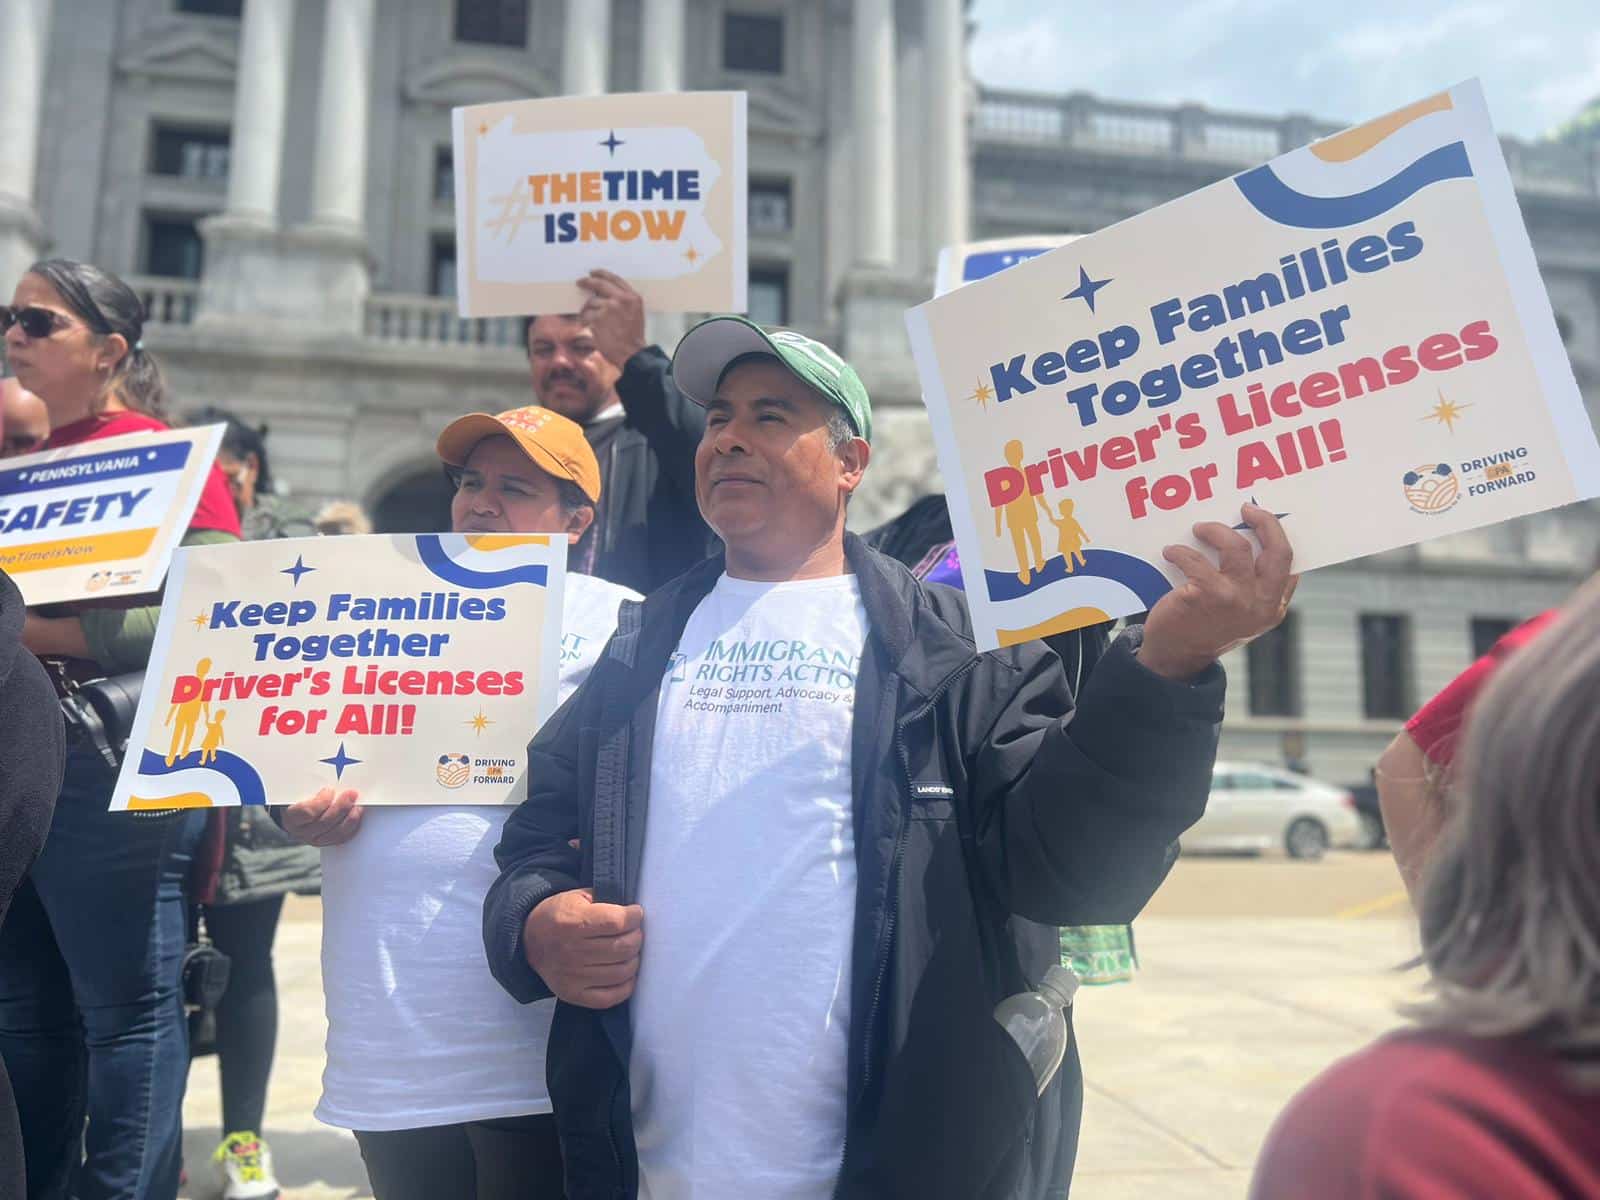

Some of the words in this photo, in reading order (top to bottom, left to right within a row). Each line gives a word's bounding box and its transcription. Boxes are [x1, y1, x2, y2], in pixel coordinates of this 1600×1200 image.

[990, 326, 1141, 402] Keep
[1150, 221, 1424, 345] Families
[1066, 305, 1351, 427] Together
[984, 413, 1207, 508] Driver's
[1217, 320, 1499, 436] Licenses
[29, 455, 139, 484] PENNSYLVANIA
[1125, 463, 1218, 519] for
[1236, 418, 1348, 489] All!
[1461, 447, 1528, 473] DRIVING
[1468, 470, 1536, 497] FORWARD
[209, 601, 316, 629] Keep
[327, 593, 506, 621] Families
[253, 629, 449, 661] Together
[171, 668, 330, 704] Driver's
[342, 665, 524, 696] Licenses
[696, 664, 772, 682] RIGHTS
[778, 664, 857, 688] ACTIO
[684, 699, 783, 716] Accompaniment
[689, 684, 722, 699] Legal
[776, 686, 839, 703] Advocacy
[258, 705, 328, 736] for
[335, 704, 416, 735] All!
[475, 759, 516, 767] DRIVING
[473, 775, 515, 784] FORWARD
